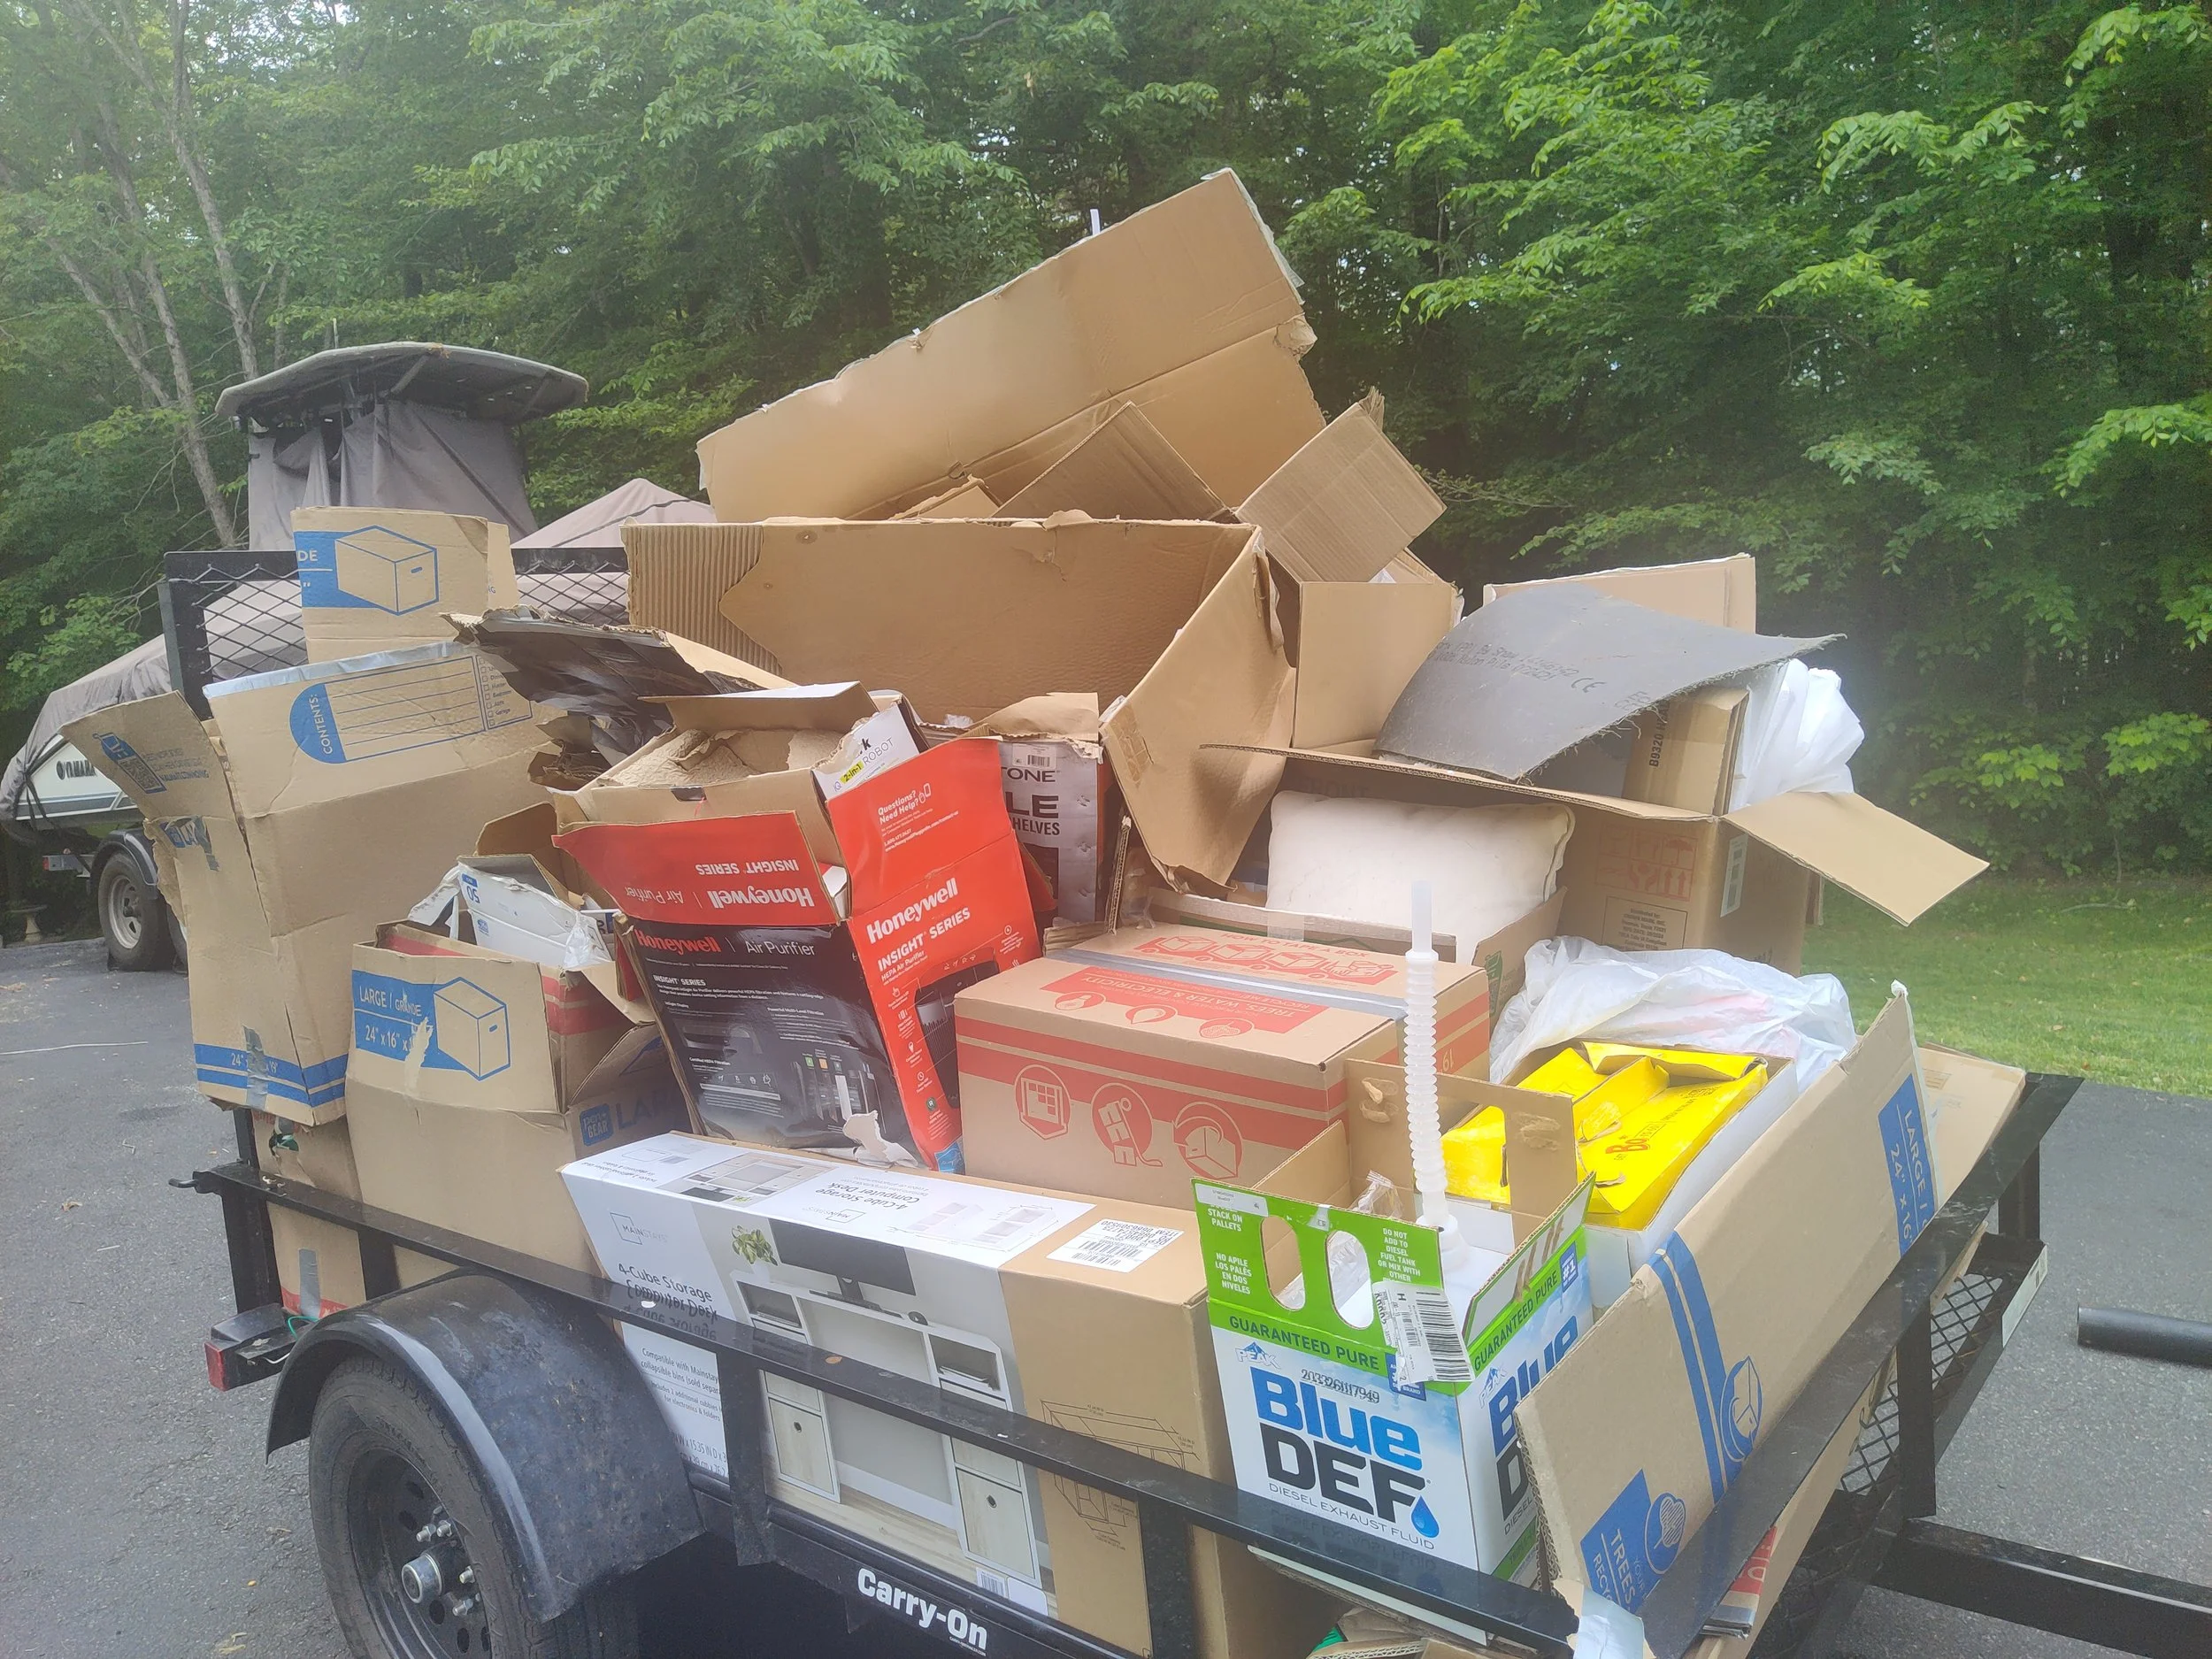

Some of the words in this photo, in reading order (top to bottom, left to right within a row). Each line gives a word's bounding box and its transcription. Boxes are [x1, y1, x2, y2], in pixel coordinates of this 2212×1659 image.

[309, 693, 333, 755] CONTENTS:
[862, 737, 895, 766] ROBOT
[1649, 733, 1664, 767] B9320
[878, 789, 917, 815] Questions?
[879, 809, 898, 825] Need
[899, 797, 919, 814] Help?
[1005, 791, 1059, 819] LE
[695, 863, 741, 875] SERIES
[746, 859, 800, 874] INSIGHT
[624, 886, 664, 903] Purifier
[669, 890, 685, 904] Air
[707, 886, 815, 909] Honeywell
[865, 877, 959, 945] Honeywell
[634, 929, 722, 955] Honeywell
[746, 940, 763, 954] Air
[767, 941, 815, 956] Purifier
[877, 933, 925, 972] INSIGHT
[928, 907, 972, 940] SERIES
[1220, 933, 1258, 943] HOW
[1282, 941, 1316, 950] TAPE
[881, 966, 896, 981] HEPA
[904, 950, 925, 969] Purifier
[653, 974, 679, 985] INSIGHT
[680, 977, 706, 987] SERIES
[1080, 975, 1170, 995] ELECTRICITY
[358, 985, 388, 1008] LARGE
[1185, 995, 1240, 1008] WATER
[1246, 1002, 1296, 1018] TREES,
[588, 1119, 608, 1139] GEAR
[1904, 1110, 1927, 1197] LARGE
[815, 1188, 860, 1202] Storage
[830, 1181, 859, 1193] Desk
[860, 1188, 920, 1204] Computer
[863, 1196, 909, 1210] 4-Cube
[1208, 1208, 1231, 1220] STACK
[1232, 1214, 1242, 1223] ON
[1211, 1217, 1242, 1232] PALLETS
[1383, 1227, 1393, 1237] DO
[1394, 1229, 1408, 1240] NOT
[1384, 1236, 1398, 1247] ADD
[1400, 1239, 1409, 1248] TO
[1216, 1252, 1226, 1263] NO
[1228, 1256, 1248, 1267] APILE
[1380, 1252, 1396, 1263] FUEL
[1398, 1256, 1416, 1267] TANK
[1386, 1245, 1409, 1257] DIESEL
[1215, 1260, 1228, 1271] LOS
[1378, 1259, 1387, 1269] OR
[1388, 1262, 1402, 1271] MIX
[1402, 1265, 1422, 1277] WITH
[618, 1263, 662, 1286] 4-Cube
[662, 1276, 713, 1303] Storage
[1221, 1271, 1232, 1281] EN
[1233, 1273, 1248, 1285] DOS
[1389, 1270, 1411, 1282] OTHER
[1221, 1279, 1250, 1294] NIVELES
[1474, 1298, 1534, 1372] GUARANTEED
[1534, 1271, 1558, 1305] PURE
[1229, 1315, 1331, 1356] GUARANTEED
[1335, 1346, 1380, 1371] PURE
[641, 1347, 675, 1367] Compatible
[675, 1360, 690, 1372] with
[1234, 1342, 1282, 1370] PEAK
[641, 1360, 672, 1378] collapsible
[672, 1371, 686, 1382] bins
[686, 1374, 701, 1387] (sold
[1248, 1365, 1424, 1471] Blue
[1258, 1421, 1426, 1525] DEF
[1268, 1482, 1317, 1509] DIESEL
[1320, 1502, 1387, 1532] EXHAUST
[1391, 1525, 1435, 1550] FLUID
[1503, 1495, 1533, 1536] DIESEL
[1634, 1557, 1646, 1592] YOUR
[857, 1567, 988, 1651] Carry-On
